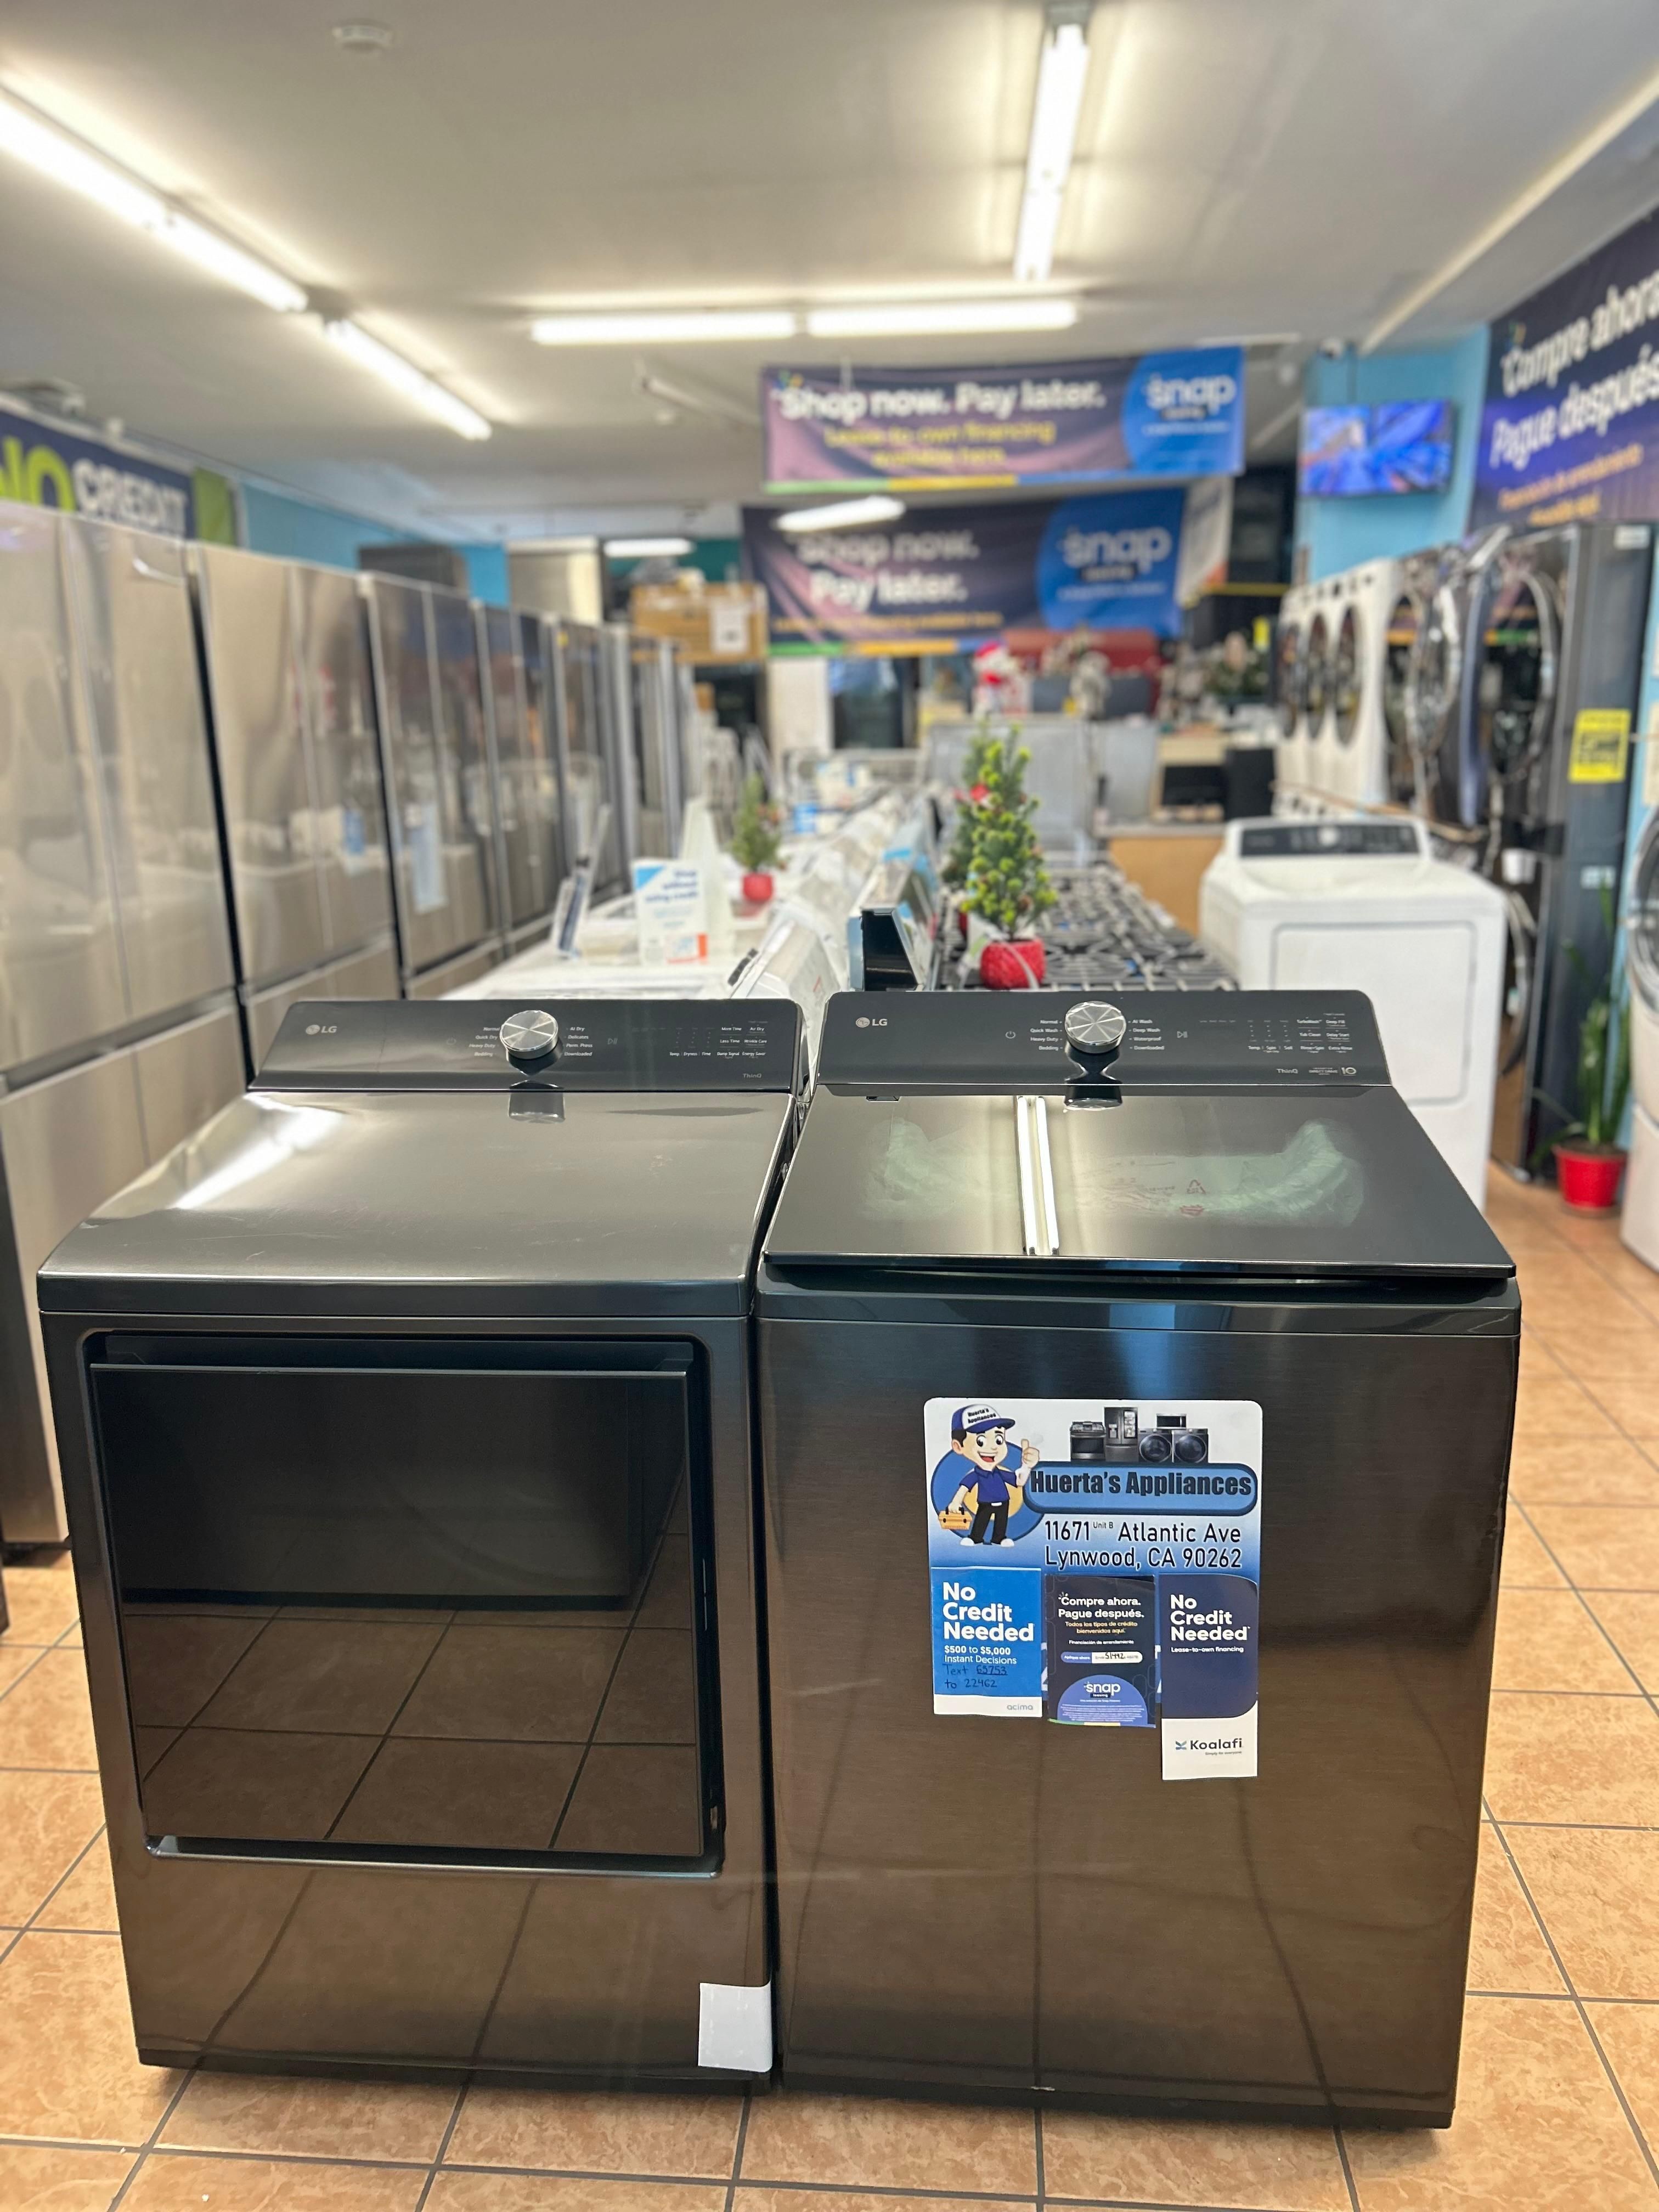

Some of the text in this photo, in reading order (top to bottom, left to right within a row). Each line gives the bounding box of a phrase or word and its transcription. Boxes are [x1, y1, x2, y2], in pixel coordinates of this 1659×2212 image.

[780, 379, 1106, 425] Shop now. Pay later.
[1146, 375, 1236, 416] snap
[1490, 405, 1558, 471] Pague
[1063, 527, 1172, 574] snap
[810, 568, 968, 611] Pay later.
[1031, 1471, 1251, 1497] Huerta's Appliances
[1045, 1520, 1090, 1541] 11671
[1118, 1521, 1196, 1542] Atlantic
[1203, 1522, 1240, 1543] Ave
[1046, 1545, 1241, 1570] Lynwood, CA 90262
[943, 1582, 976, 1601] No
[1060, 1596, 1141, 1607] Compre ahora.
[1170, 1594, 1197, 1610] No
[943, 1602, 1012, 1622] Credit
[1058, 1609, 1144, 1620] Pague después.
[1170, 1610, 1232, 1625] Credit
[944, 1621, 1034, 1641] Needed
[944, 1645, 967, 1654] $500
[980, 1646, 1011, 1656] $5,000
[975, 1655, 1017, 1664] Decisions
[944, 1679, 957, 1689] to
[1086, 1683, 1121, 1696] snap
[1190, 1737, 1243, 1750] Koalafi
